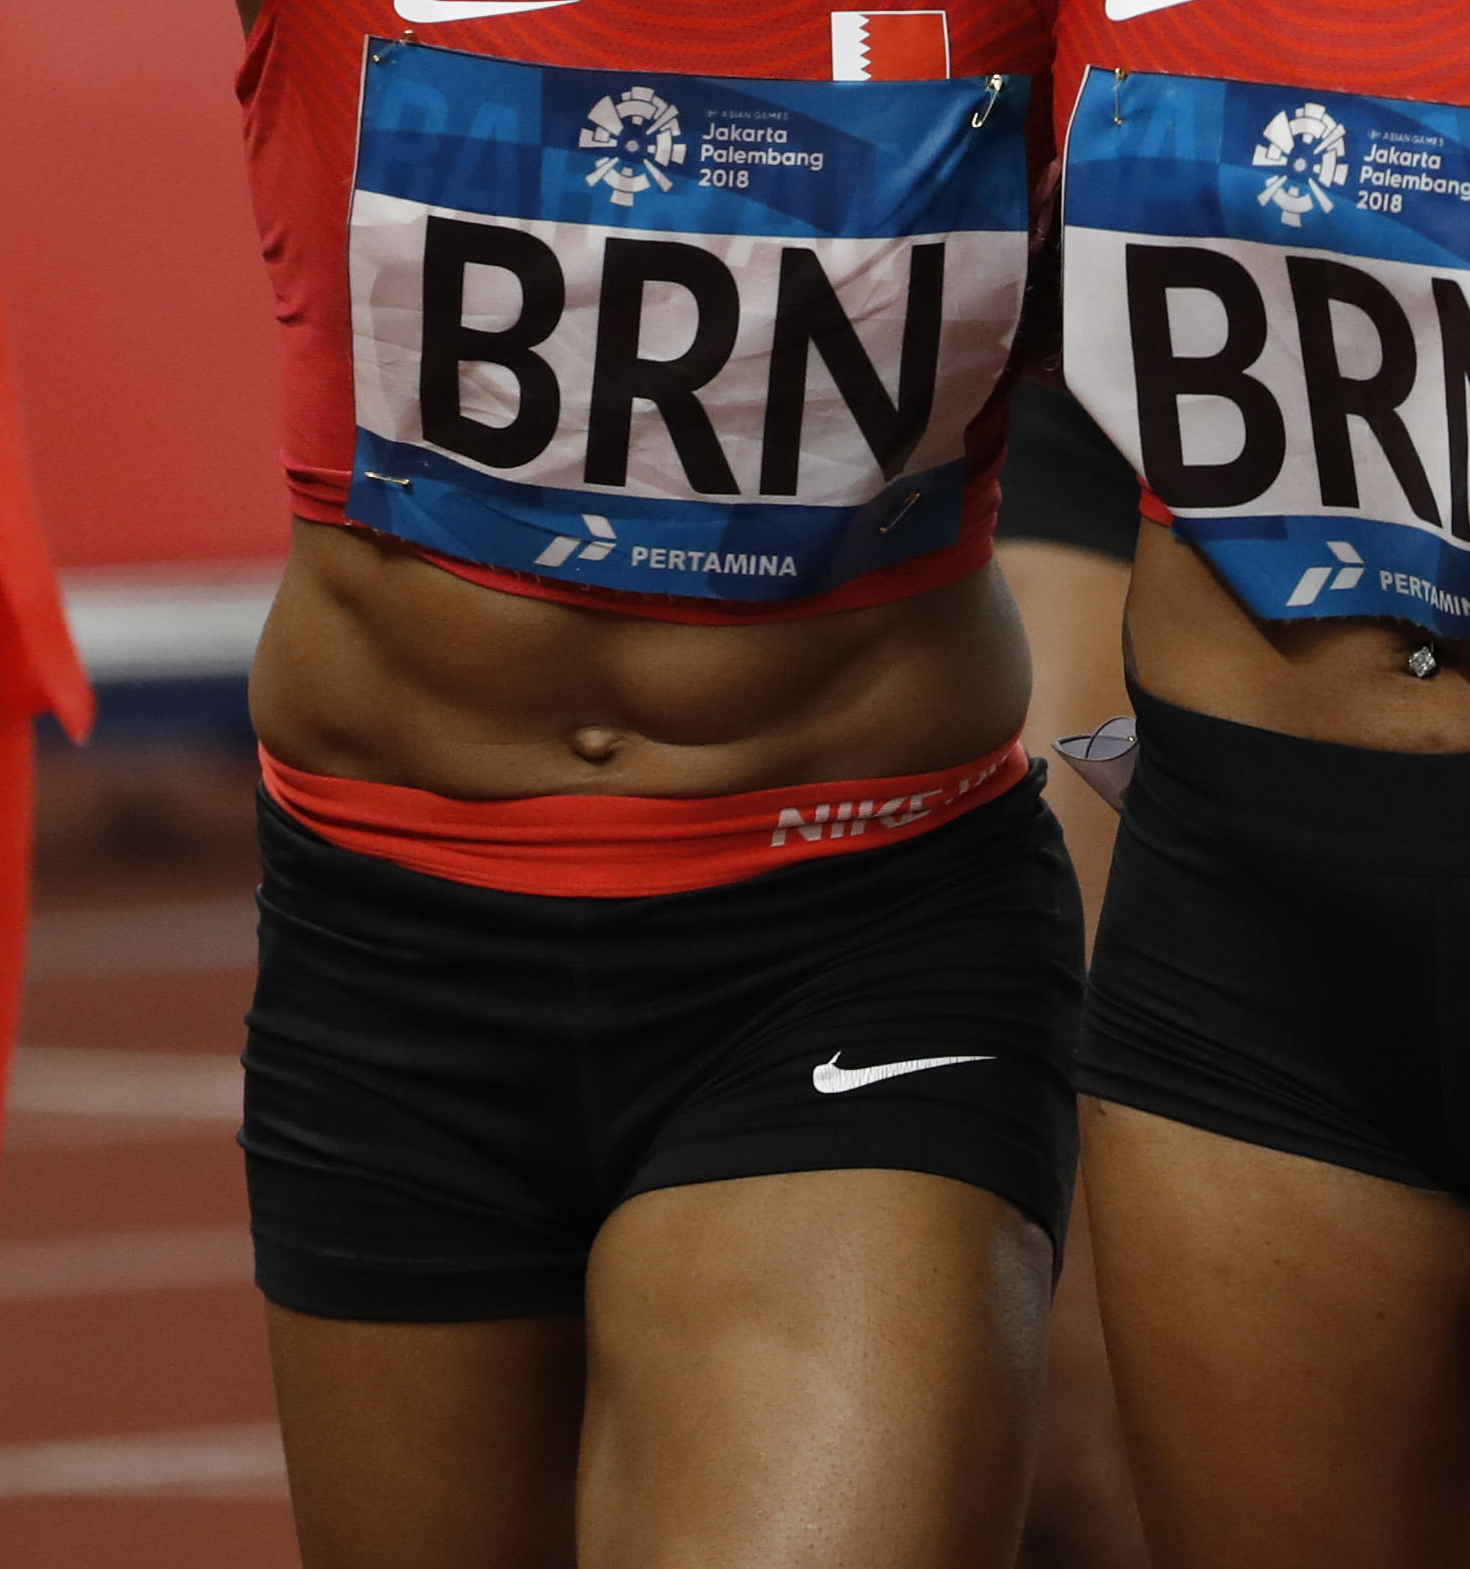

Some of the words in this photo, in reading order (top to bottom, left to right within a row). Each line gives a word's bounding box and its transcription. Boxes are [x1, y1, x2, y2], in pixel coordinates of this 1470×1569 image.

[702, 122, 788, 144] Jakarta
[700, 144, 824, 171] Palembang
[1363, 143, 1442, 170] Jakarta
[698, 168, 749, 188] 2018
[1356, 190, 1403, 213] 2018
[420, 214, 946, 497] BRN
[631, 545, 798, 577] PERTAMINA
